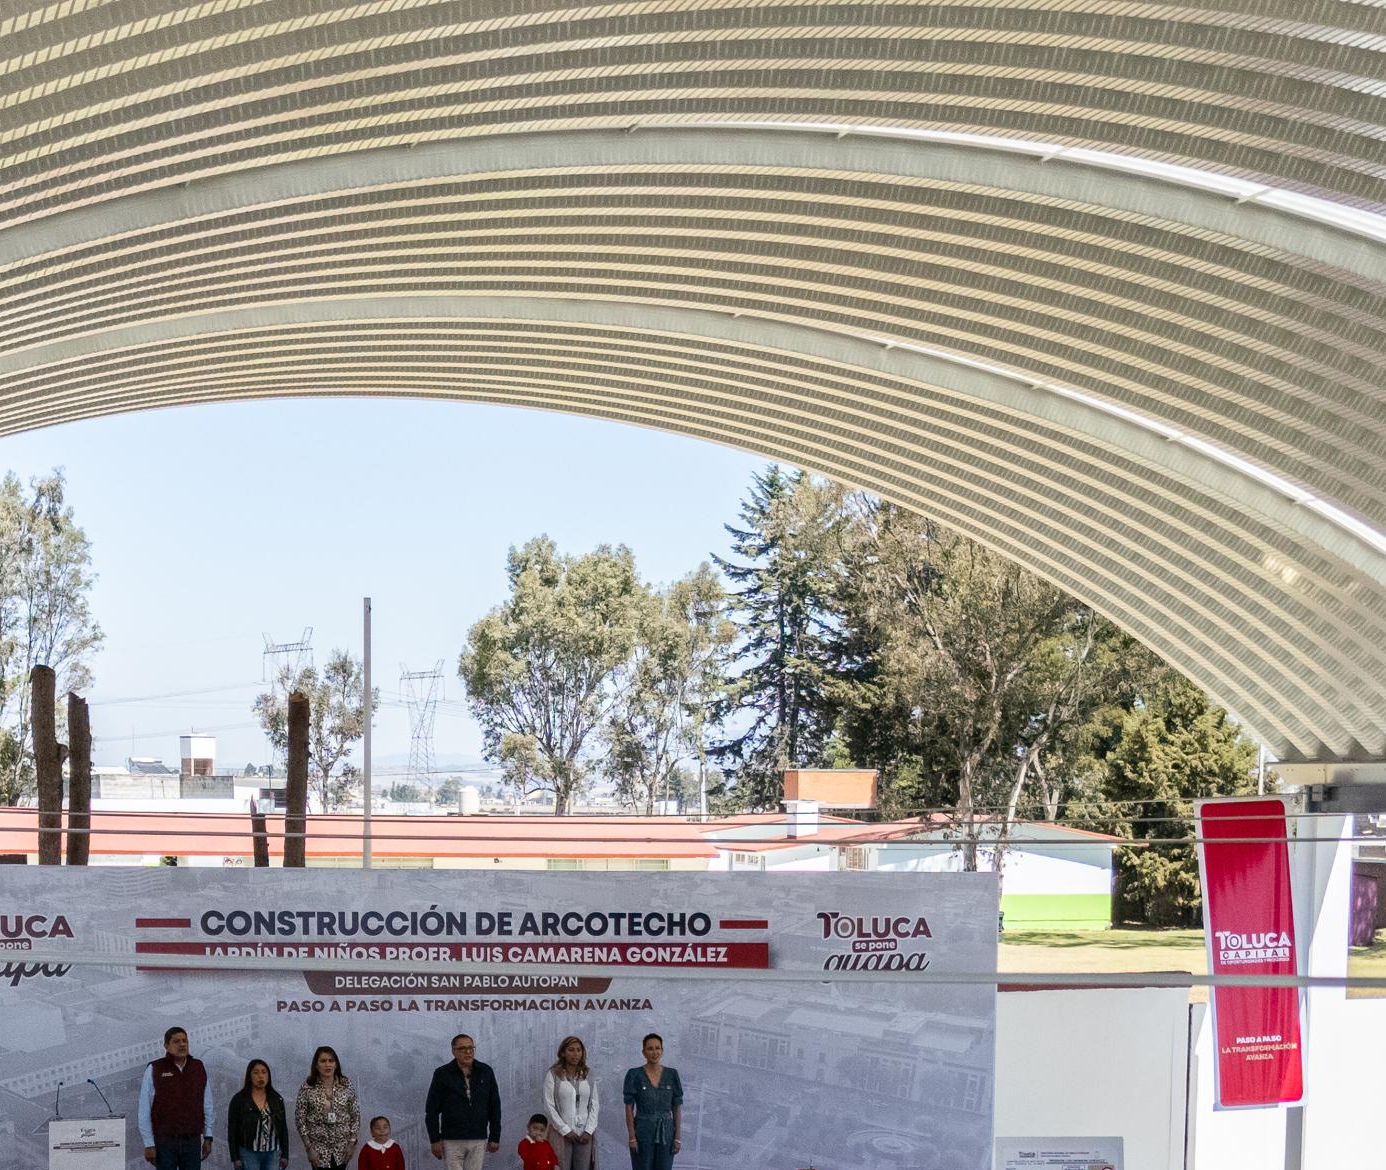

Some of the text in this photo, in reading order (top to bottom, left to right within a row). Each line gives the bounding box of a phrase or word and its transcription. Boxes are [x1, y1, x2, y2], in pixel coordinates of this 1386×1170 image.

[200, 904, 712, 937] CONSTRUCCIÓN DE ARCOTECHO
[816, 912, 933, 939] TOLUCA
[854, 941, 896, 951] se pone
[1215, 930, 1292, 950] TOLUCA
[283, 947, 309, 958] DE
[314, 943, 380, 961] NIÑOS
[386, 947, 456, 962] PROFR.
[461, 947, 503, 962] LUIS
[508, 947, 622, 963] CAMARENA
[626, 943, 728, 963] GONZÁLEZ
[1222, 949, 1287, 959] CAPITAL
[335, 972, 579, 988] DELEGACIÓN SAN PABLO AUTOPAN
[276, 996, 653, 1012] PASO A PASO LA TRANSFORMACIÓN AVANZA
[1236, 1034, 1282, 1044] PASO A PASO
